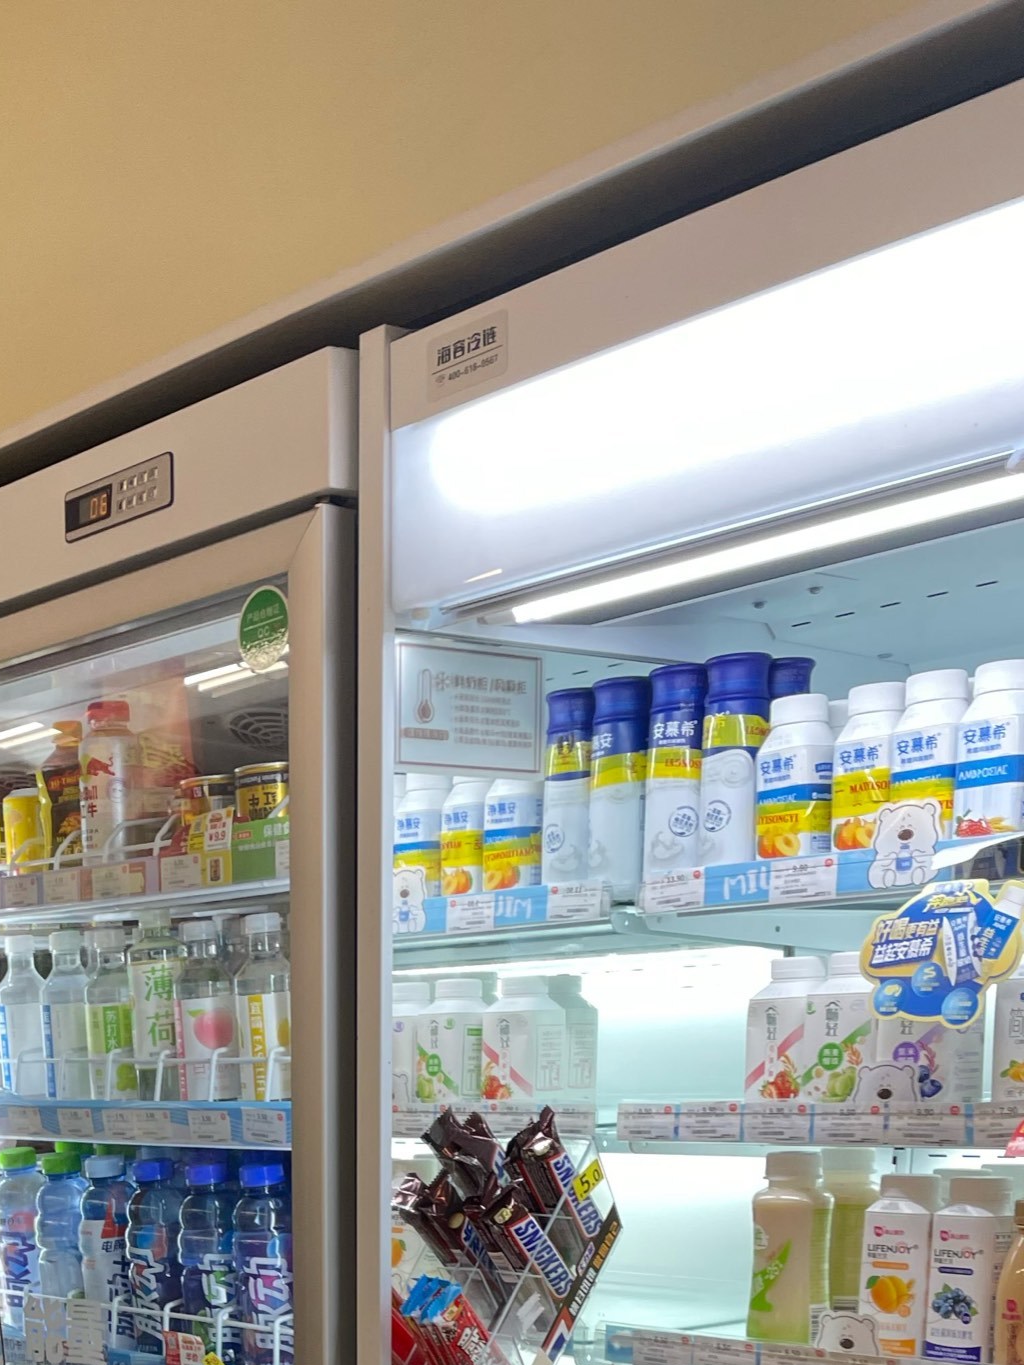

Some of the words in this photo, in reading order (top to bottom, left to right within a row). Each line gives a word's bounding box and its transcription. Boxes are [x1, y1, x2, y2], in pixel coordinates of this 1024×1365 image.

[437, 326, 497, 366] 海容冷链
[652, 720, 696, 739] 安慕希
[963, 724, 1007, 745] 安慕希
[896, 735, 939, 755] 安慕希
[760, 755, 795, 776] 安慕希
[839, 746, 880, 766] 安慕希
[143, 965, 176, 1049] 薄荷
[105, 1008, 120, 1052] 苏打水
[513, 1218, 572, 1298] SNICKERS
[867, 1243, 912, 1255] LIFENJOY
[933, 1248, 977, 1260] LIFENJOY
